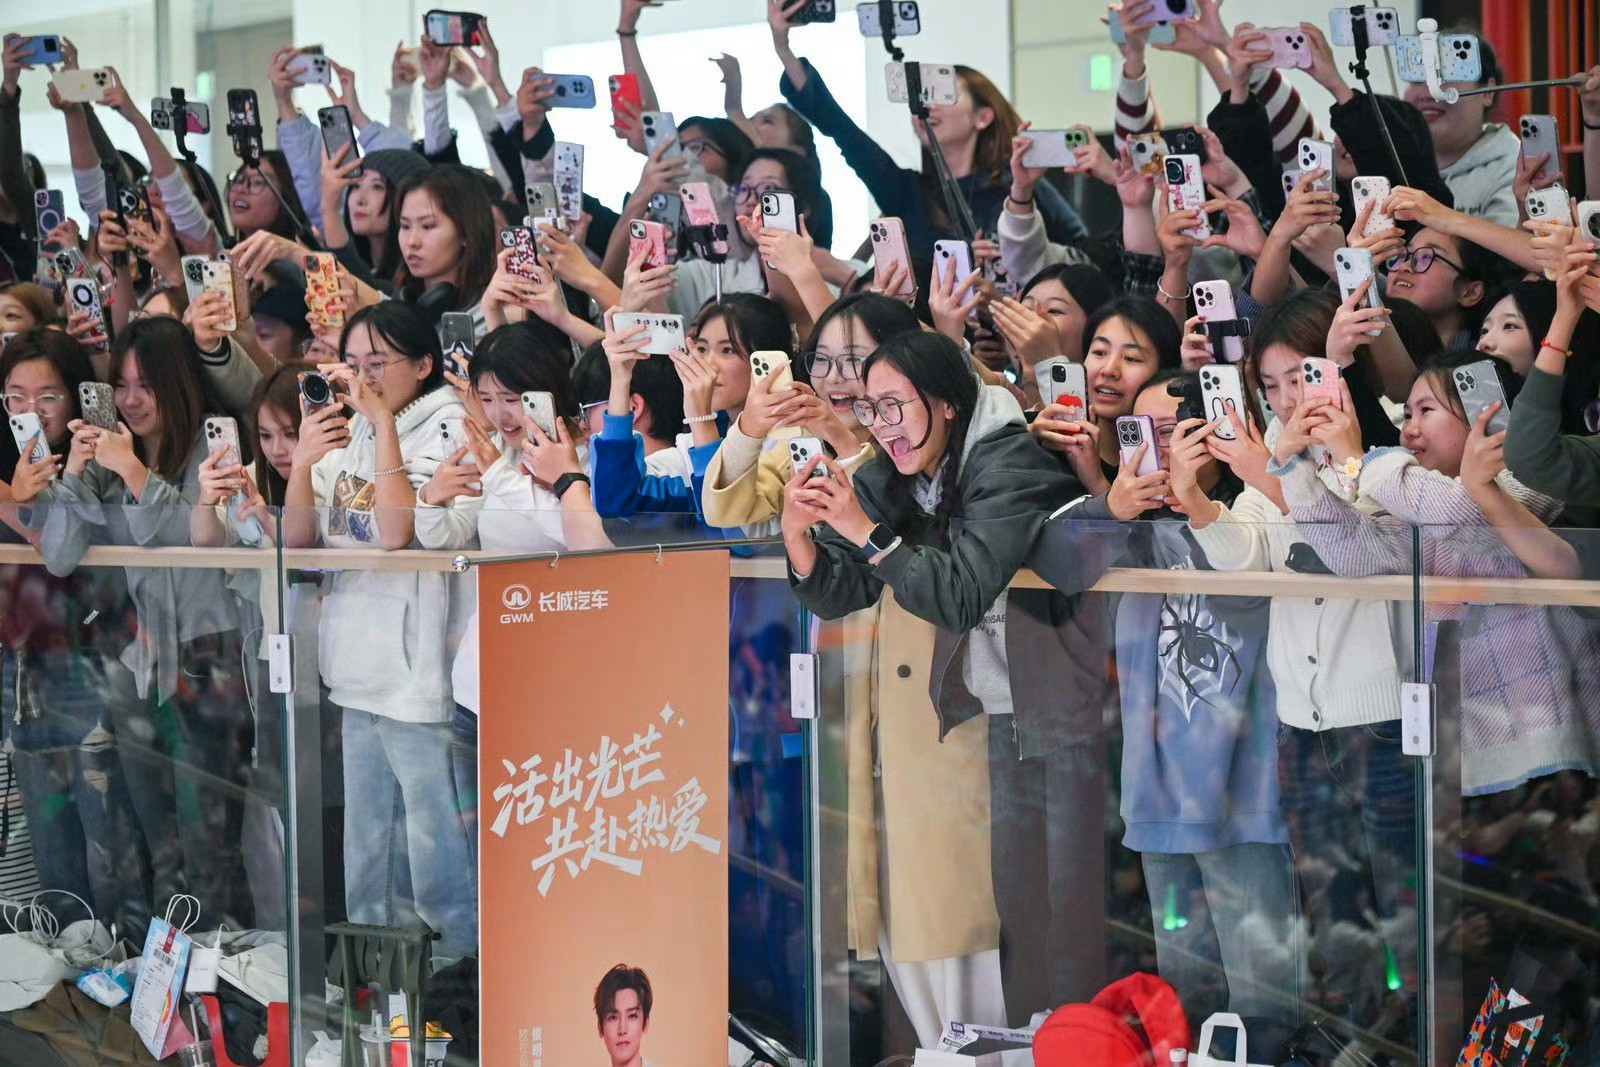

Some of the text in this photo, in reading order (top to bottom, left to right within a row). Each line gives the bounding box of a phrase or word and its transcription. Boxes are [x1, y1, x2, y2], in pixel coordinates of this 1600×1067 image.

[500, 613, 534, 624] GWM
[538, 590, 609, 612] 长城汽车
[490, 724, 666, 838] 活出光芒
[531, 776, 721, 897] 共赴热爱
